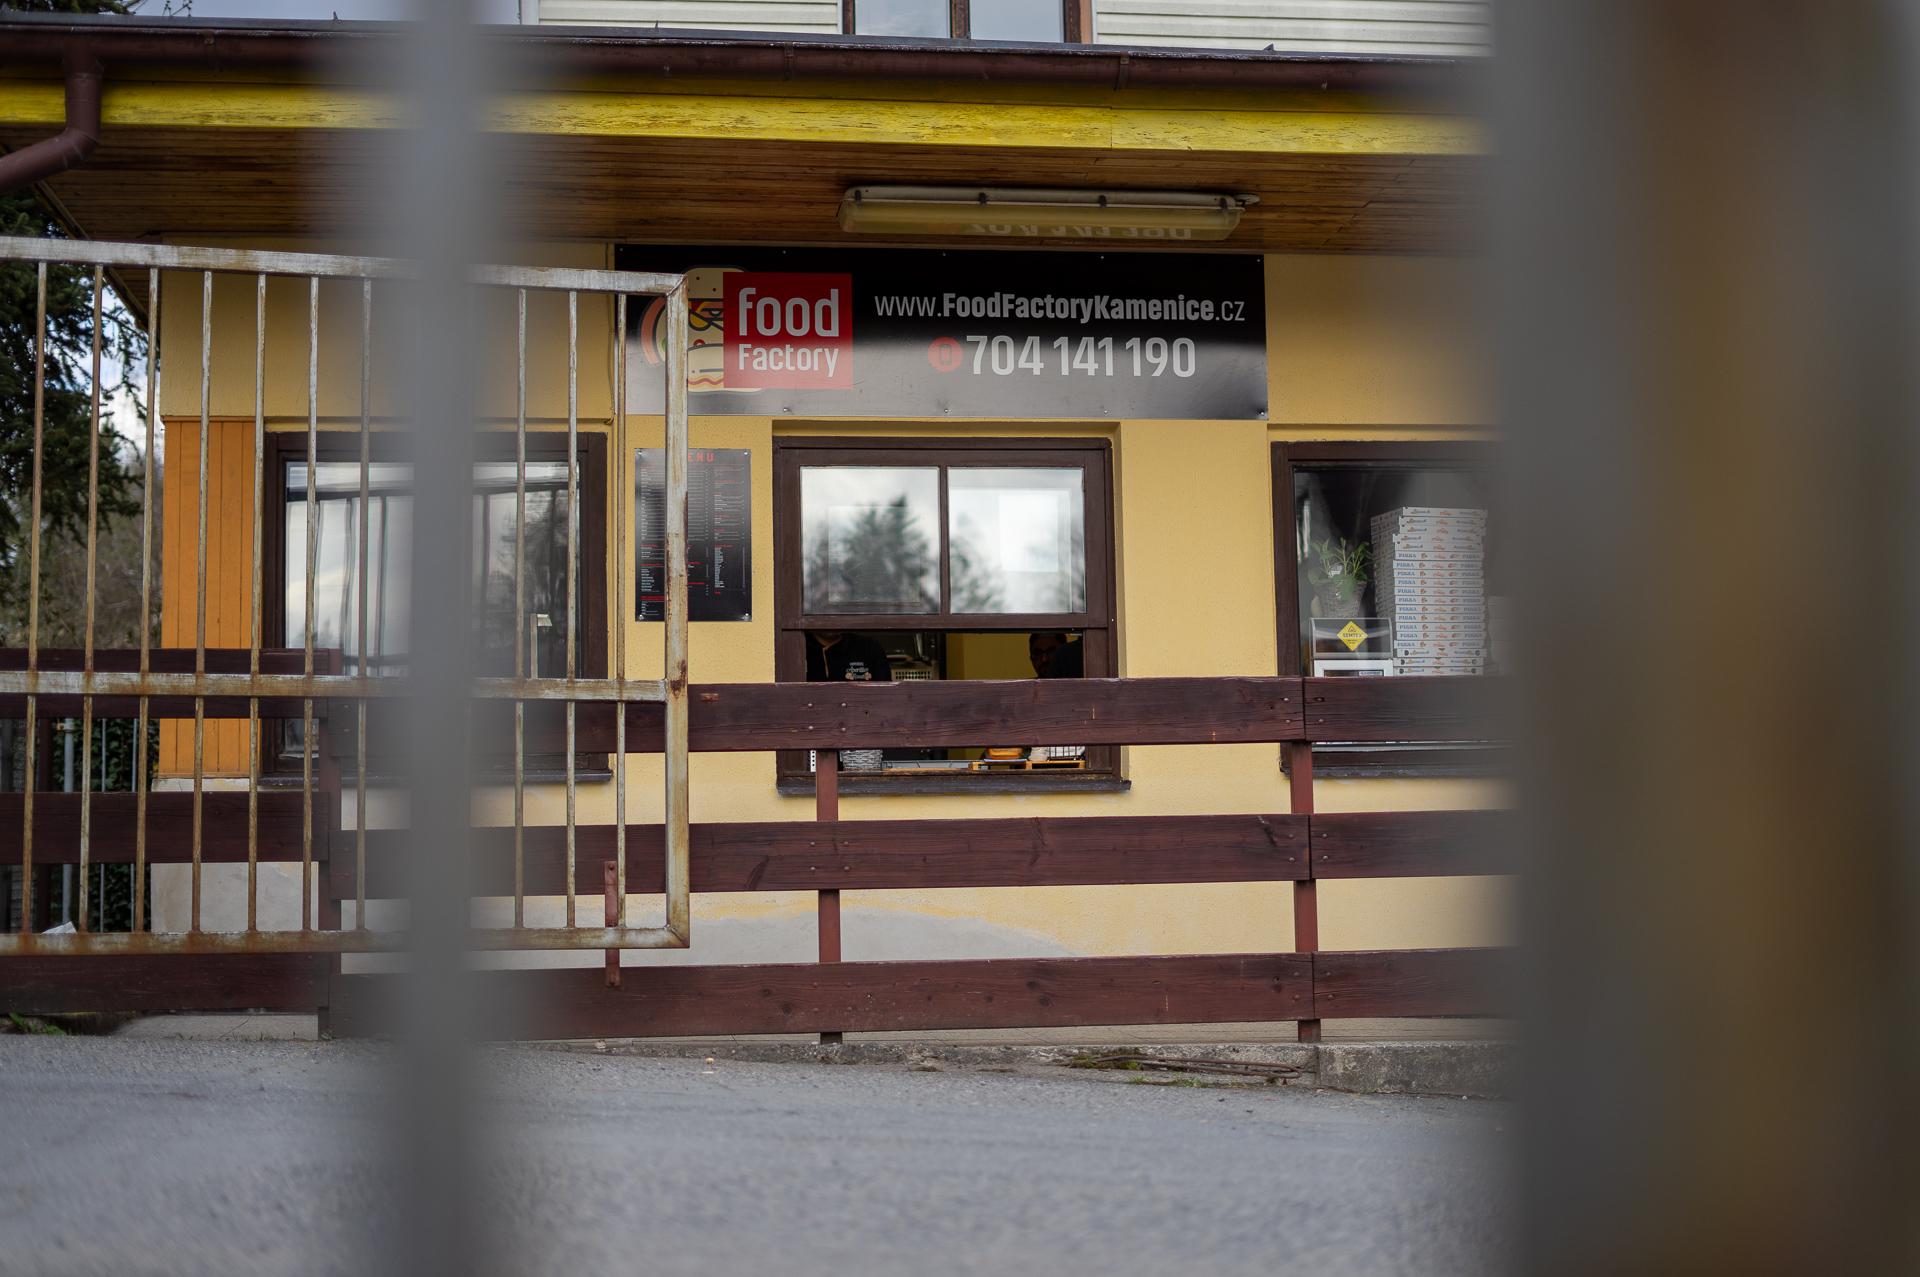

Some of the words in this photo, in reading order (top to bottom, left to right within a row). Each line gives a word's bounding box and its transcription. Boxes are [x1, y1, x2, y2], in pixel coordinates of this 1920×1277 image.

[739, 287, 840, 337] food
[875, 292, 1246, 324] www.FoodFactoryKamenice.cz
[738, 343, 839, 377] Factory
[966, 335, 1044, 375] 704
[1053, 336, 1114, 377] 141
[1125, 337, 1196, 378] 190
